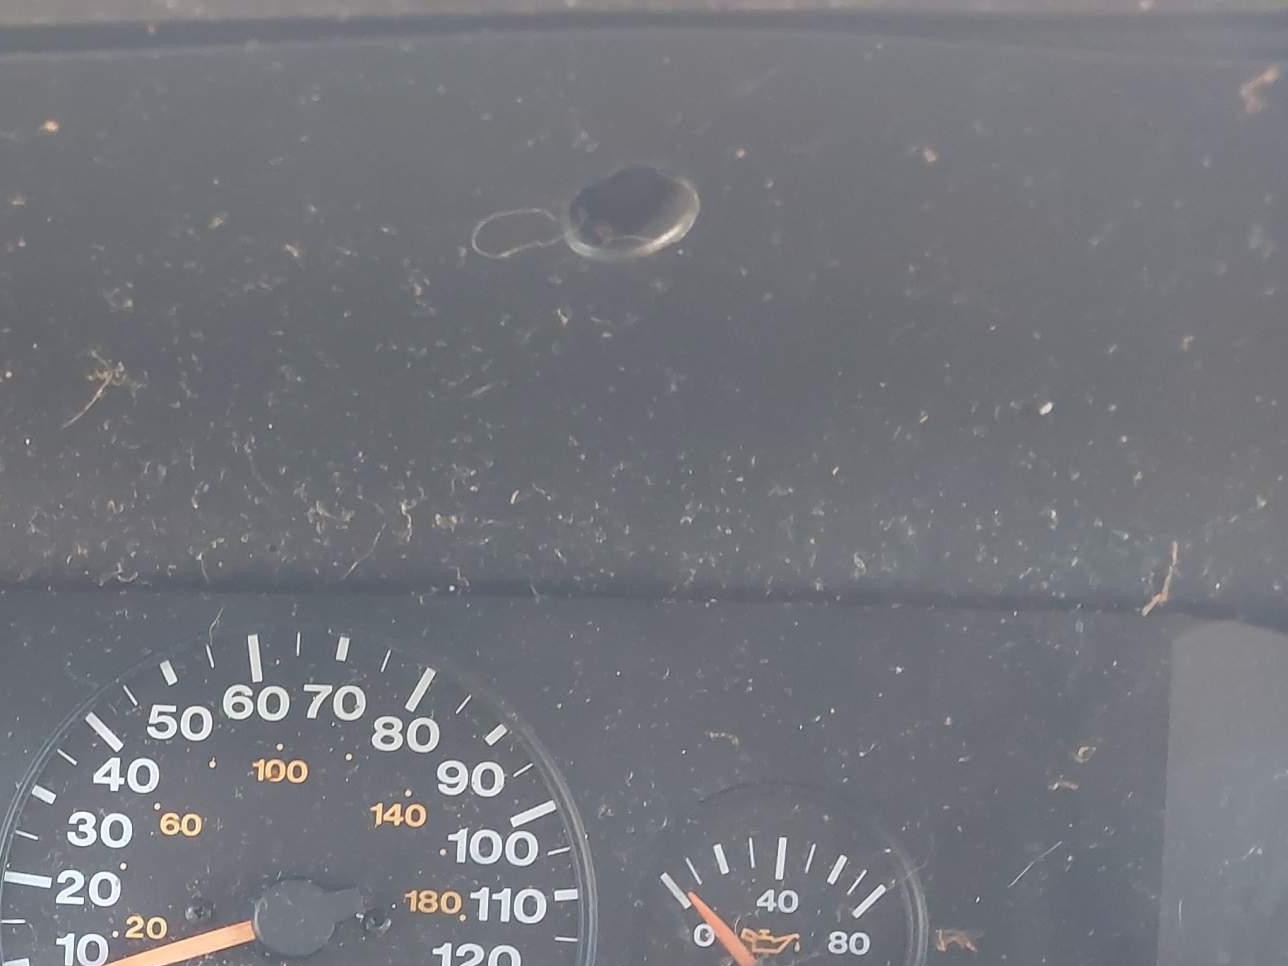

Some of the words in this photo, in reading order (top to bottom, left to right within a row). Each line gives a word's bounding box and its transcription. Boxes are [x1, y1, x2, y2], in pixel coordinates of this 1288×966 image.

[223, 684, 290, 720] 60
[303, 684, 366, 720] 70
[147, 705, 212, 741] 50
[372, 716, 440, 752] 80
[93, 758, 159, 793] 40
[253, 760, 308, 783] 100
[436, 760, 505, 797] 90
[67, 812, 133, 847] 30
[159, 814, 202, 837] 60
[370, 804, 426, 827] 140
[447, 829, 539, 866] 100
[55, 870, 121, 907] 20
[405, 891, 461, 914] 180
[470, 888, 546, 924] 110
[756, 889, 799, 913] 40
[125, 916, 168, 939] 20
[693, 924, 715, 948] 0
[828, 931, 871, 956] 80
